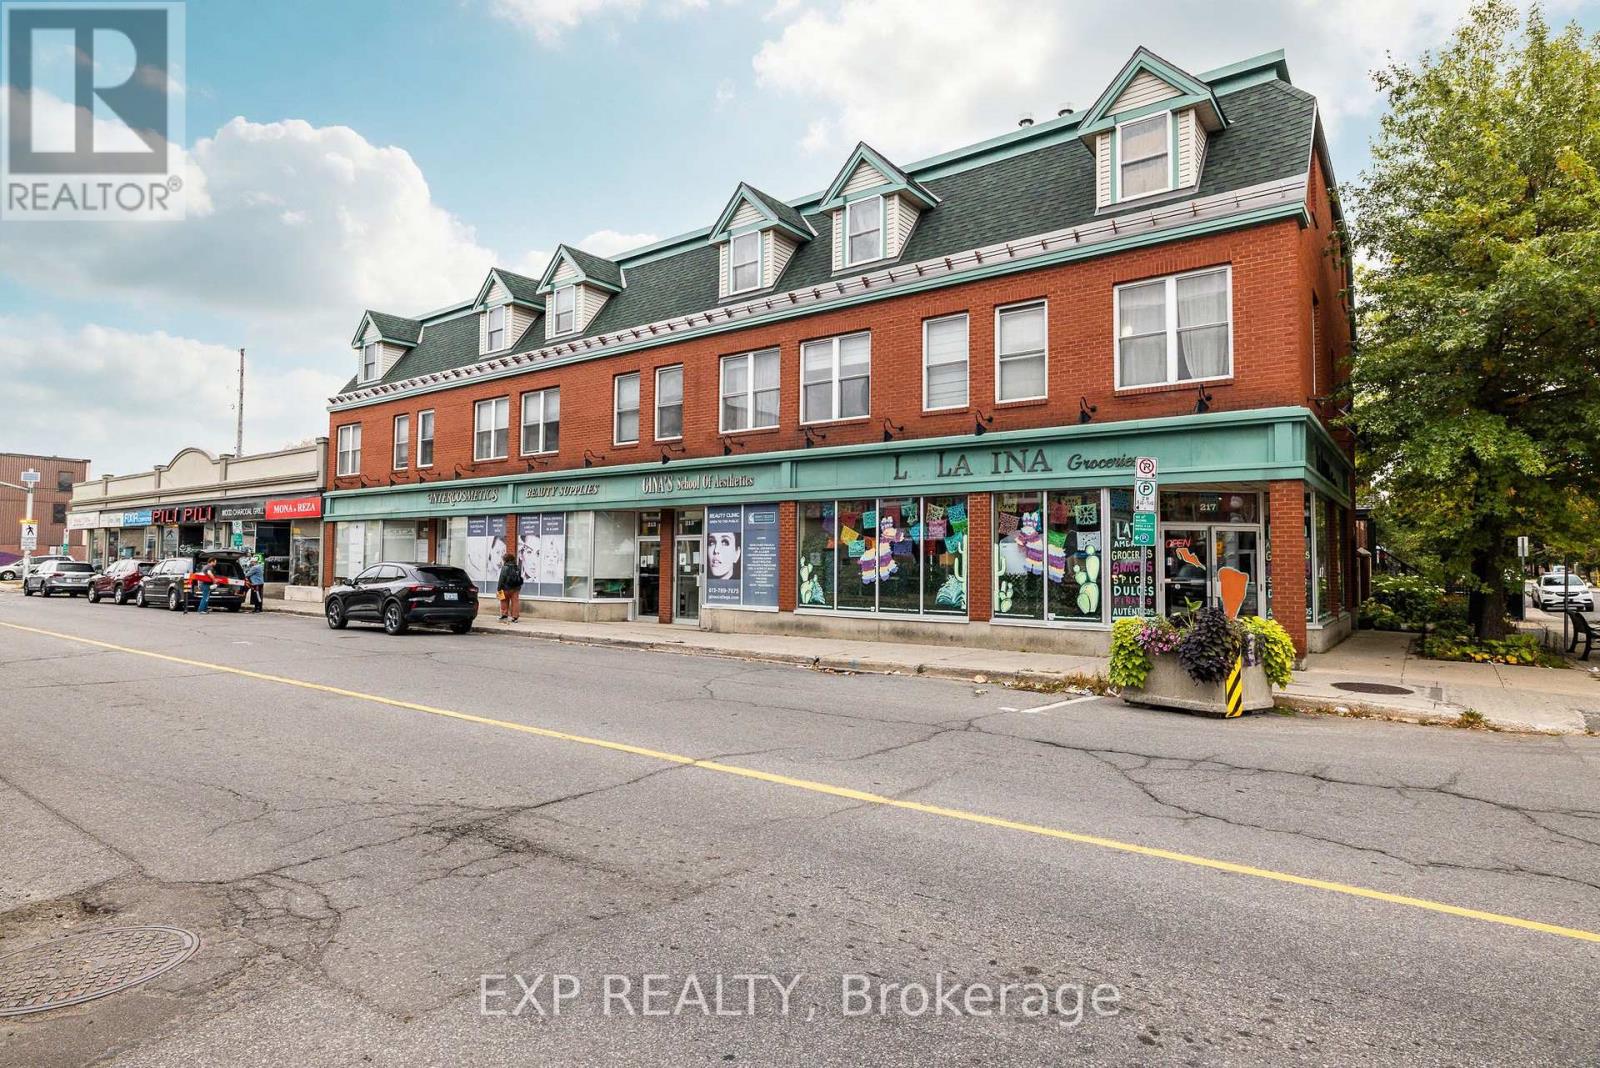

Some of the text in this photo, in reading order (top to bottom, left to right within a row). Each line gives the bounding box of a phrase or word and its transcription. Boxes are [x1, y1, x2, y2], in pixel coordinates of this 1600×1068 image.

[893, 454, 908, 480] L
[937, 451, 974, 478] LA
[991, 448, 1053, 475] INA
[642, 472, 754, 494] GINA'S School Of Aesthetics
[427, 488, 499, 507] INTERCOSMETICS
[526, 484, 600, 499] BEAUTY SUPPLIES
[233, 507, 252, 516] CHARCOAL
[273, 504, 293, 514] MONA
[297, 502, 316, 512] REZA
[1199, 503, 1217, 511] 217
[152, 505, 212, 524] PILI PILI
[1165, 537, 1191, 548] OPEN
[1111, 549, 1153, 561] GROCERS
[1112, 561, 1153, 575] SNACS
[1112, 575, 1153, 585] SPICS
